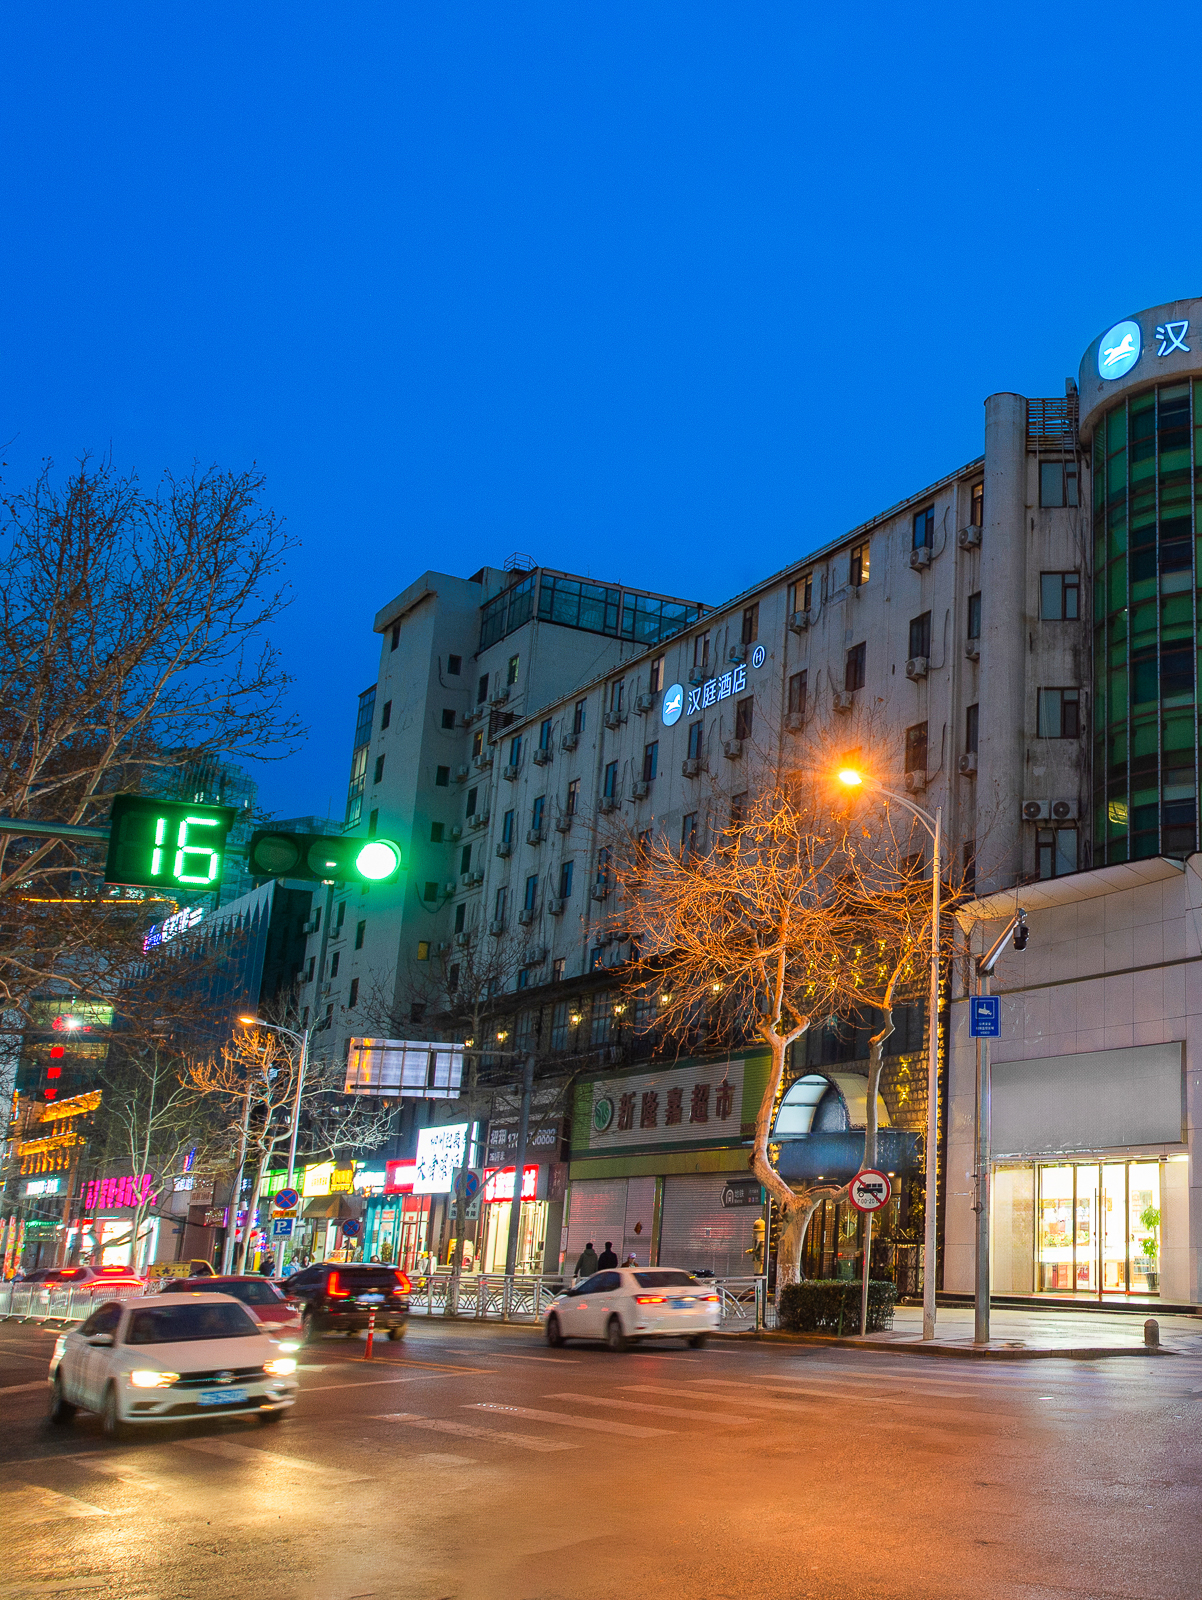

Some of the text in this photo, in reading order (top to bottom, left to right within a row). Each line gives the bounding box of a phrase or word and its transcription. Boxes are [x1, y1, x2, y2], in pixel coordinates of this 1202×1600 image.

[687, 664, 747, 715] 汉庭酒店
[151, 816, 220, 884] 16
[617, 1079, 735, 1131] 新隆嘉超市
[275, 1221, 287, 1233] P
